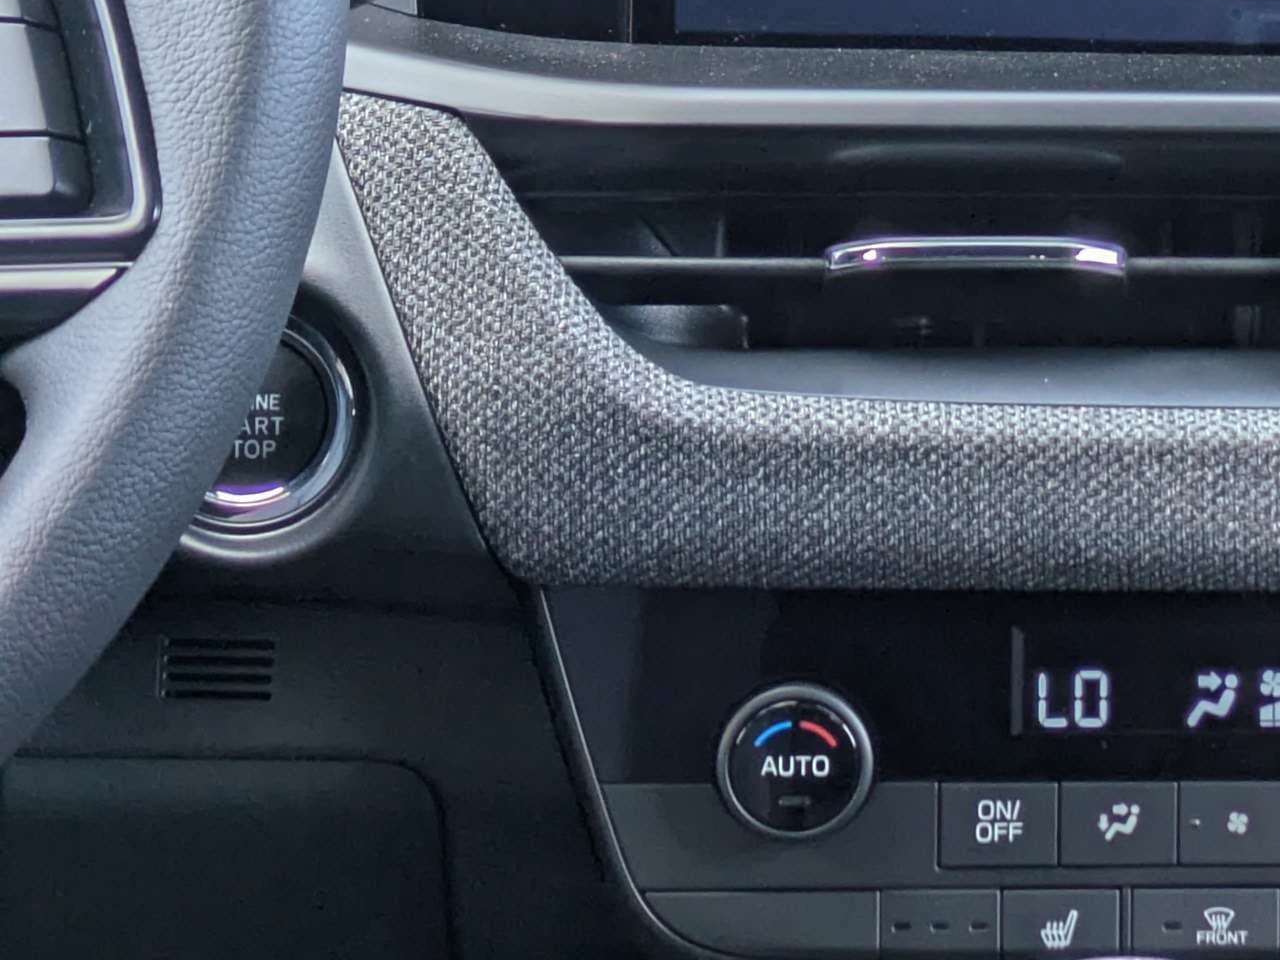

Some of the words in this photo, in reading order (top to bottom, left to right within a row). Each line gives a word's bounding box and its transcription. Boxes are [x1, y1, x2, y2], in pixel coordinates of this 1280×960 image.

[239, 415, 285, 436] ART
[232, 439, 277, 460] TOP
[760, 754, 830, 777] AUTO
[977, 799, 1021, 821] ON/
[975, 821, 1023, 843] OFF
[1196, 929, 1249, 946] FRONT
